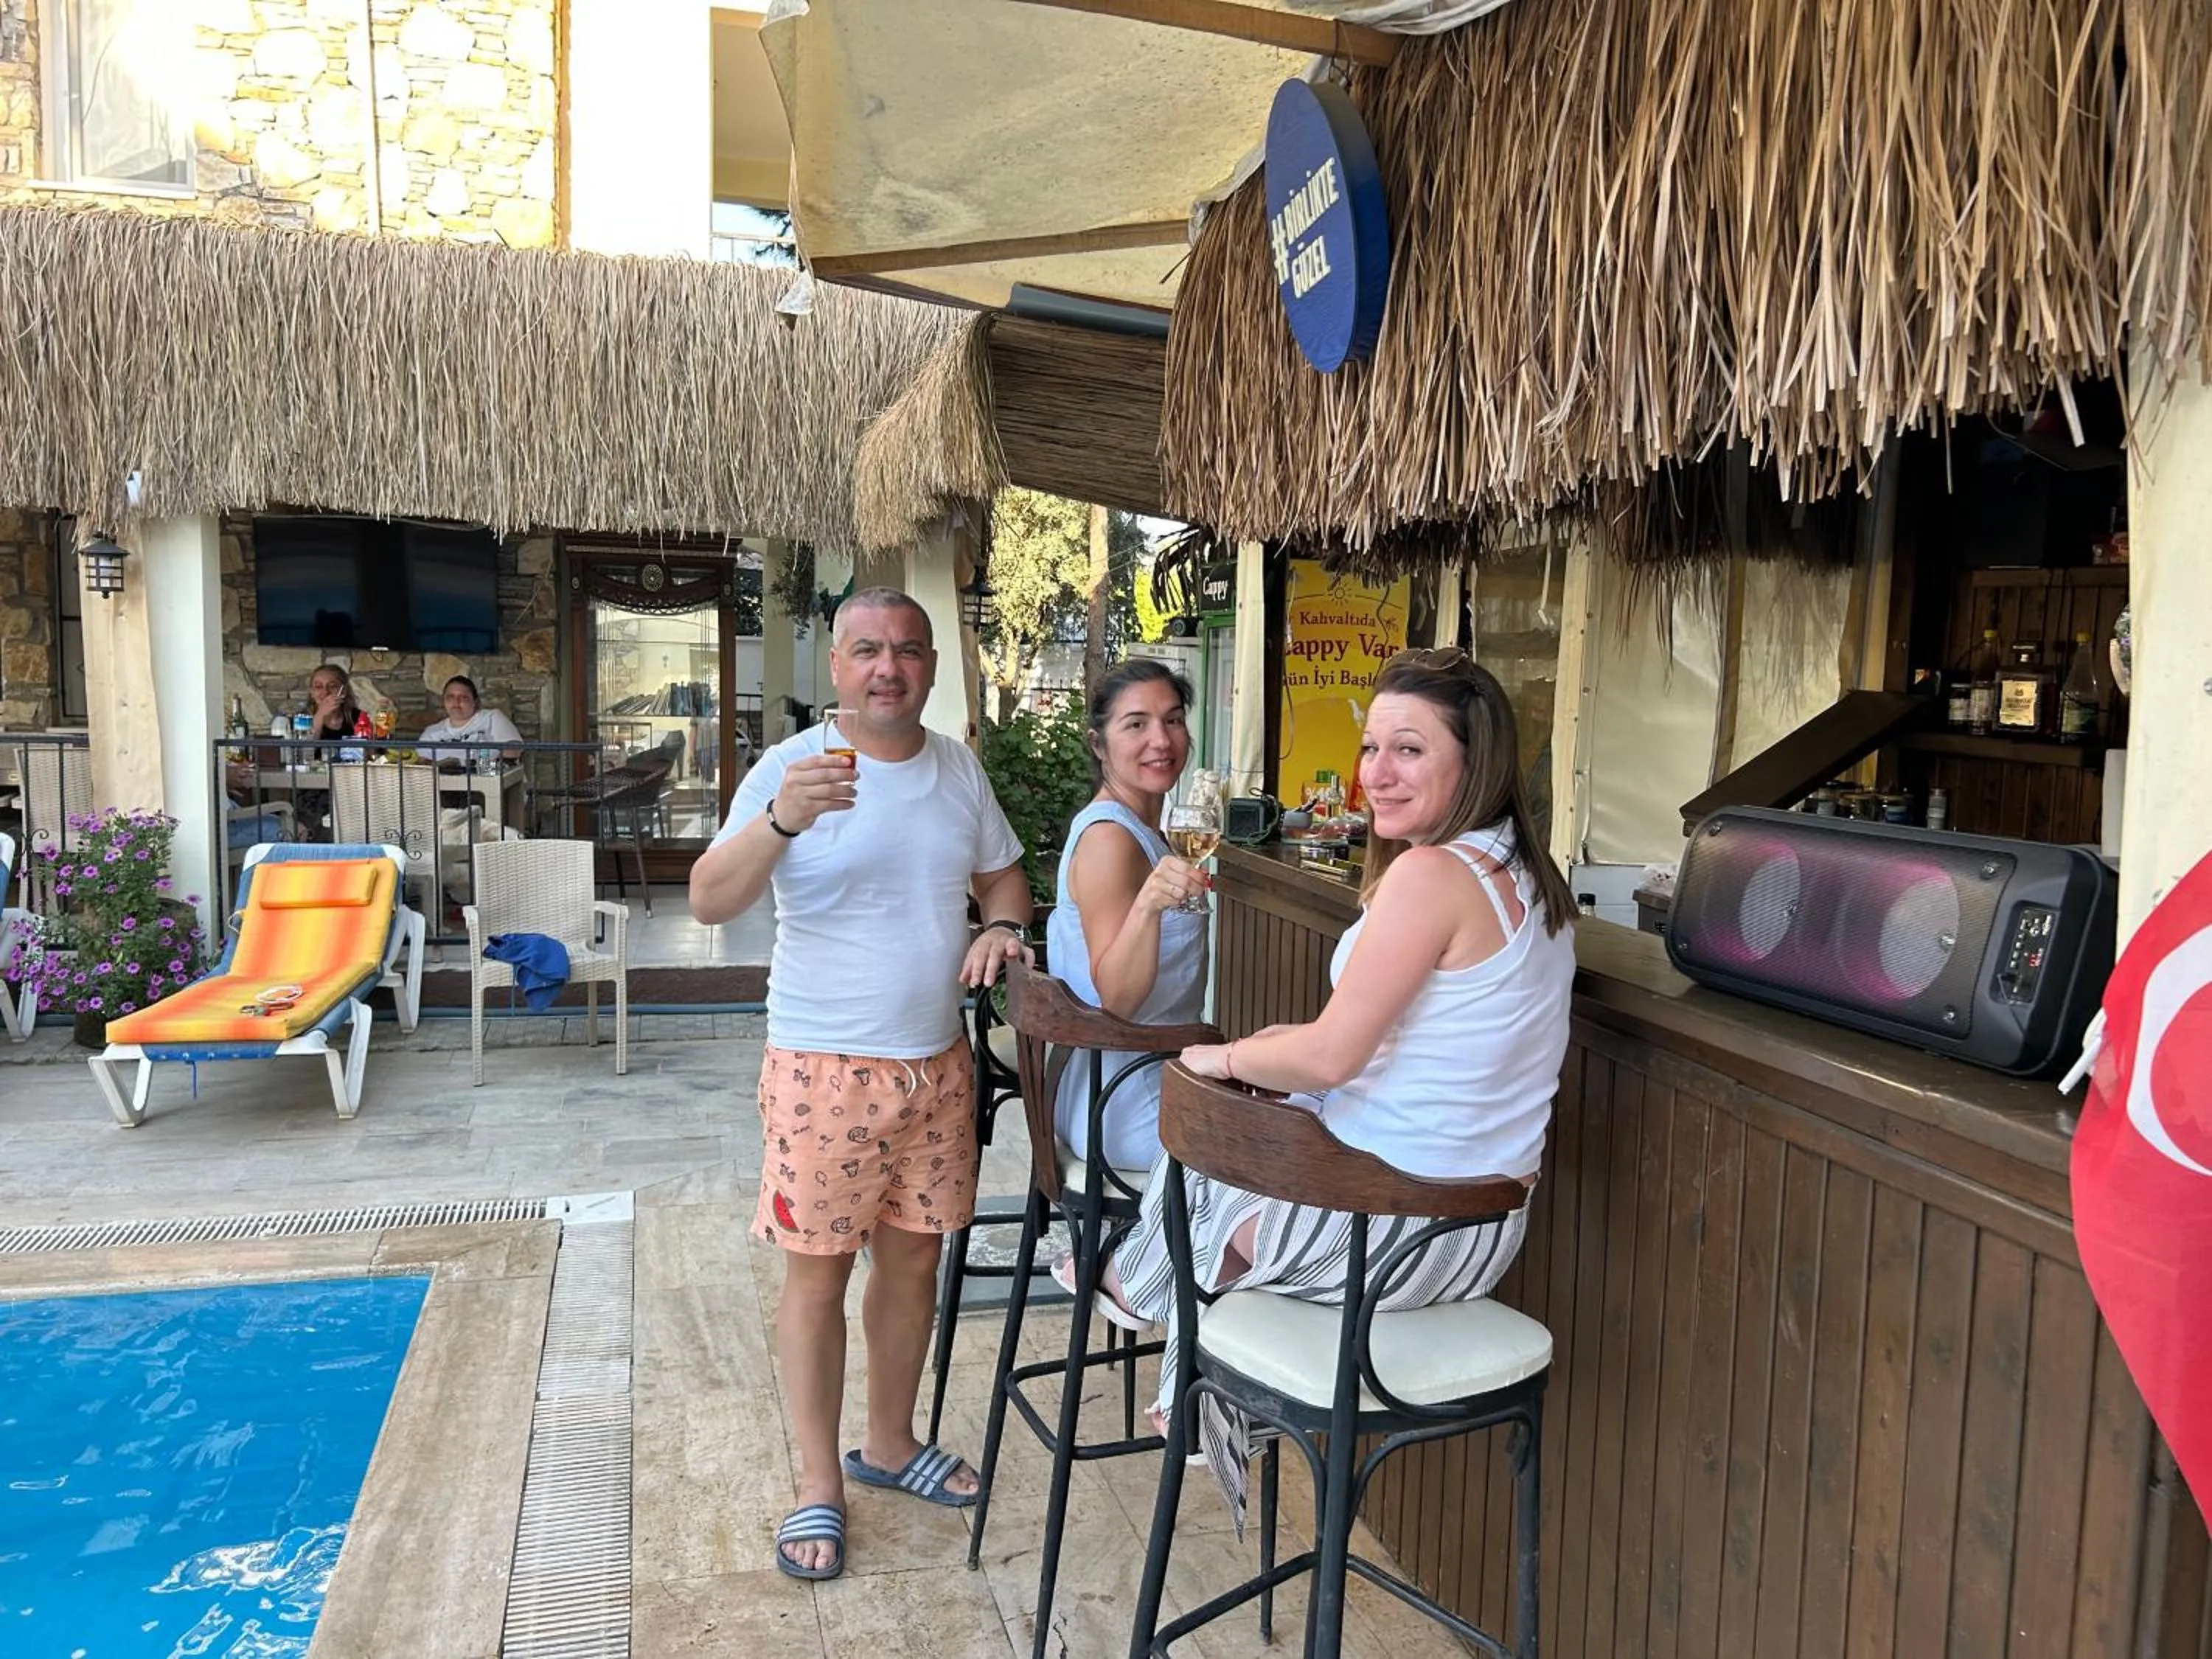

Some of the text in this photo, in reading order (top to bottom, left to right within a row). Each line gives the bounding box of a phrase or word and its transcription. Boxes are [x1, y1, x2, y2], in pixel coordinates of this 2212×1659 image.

[1203, 576, 1228, 602] Cappy
[1299, 611, 1376, 627] Kahvaltıda
[1358, 633, 1399, 658] Var
[1284, 664, 1377, 690] ün İyi Başl
